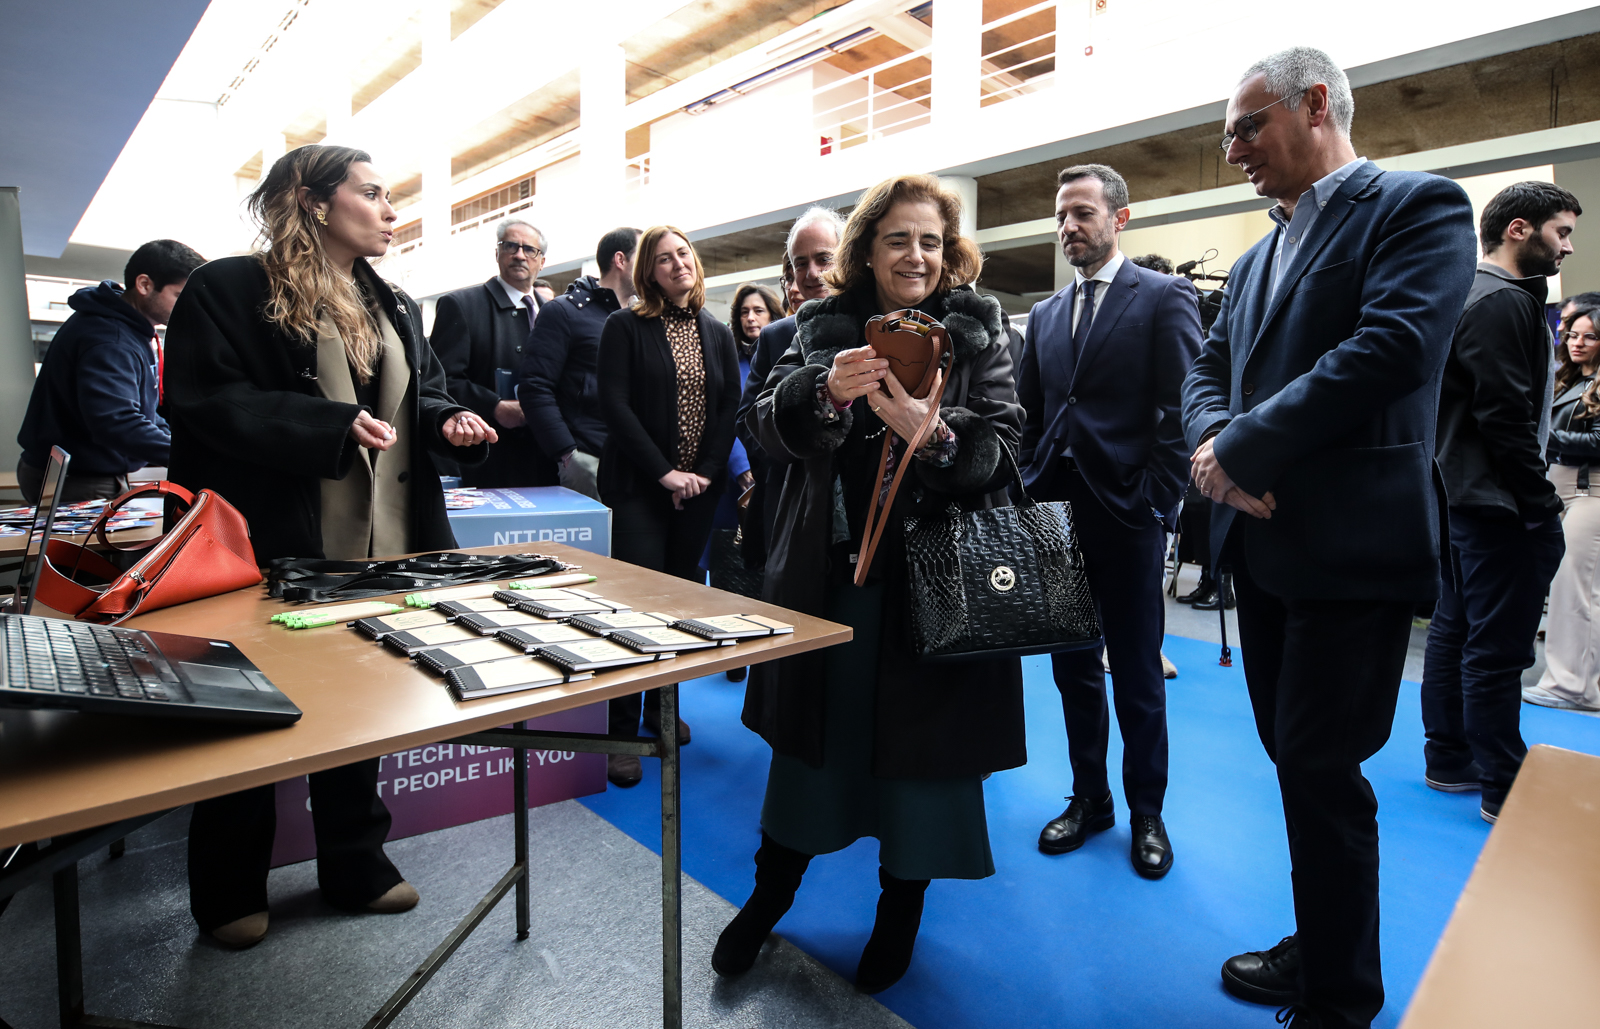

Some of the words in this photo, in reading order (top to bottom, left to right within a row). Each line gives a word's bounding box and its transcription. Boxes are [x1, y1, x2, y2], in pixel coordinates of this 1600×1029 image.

[494, 530, 536, 546] NTT
[392, 744, 453, 769] TECH
[394, 763, 480, 795] PEOPLE
[487, 753, 530, 777] LIK
[535, 750, 575, 766] YOU
